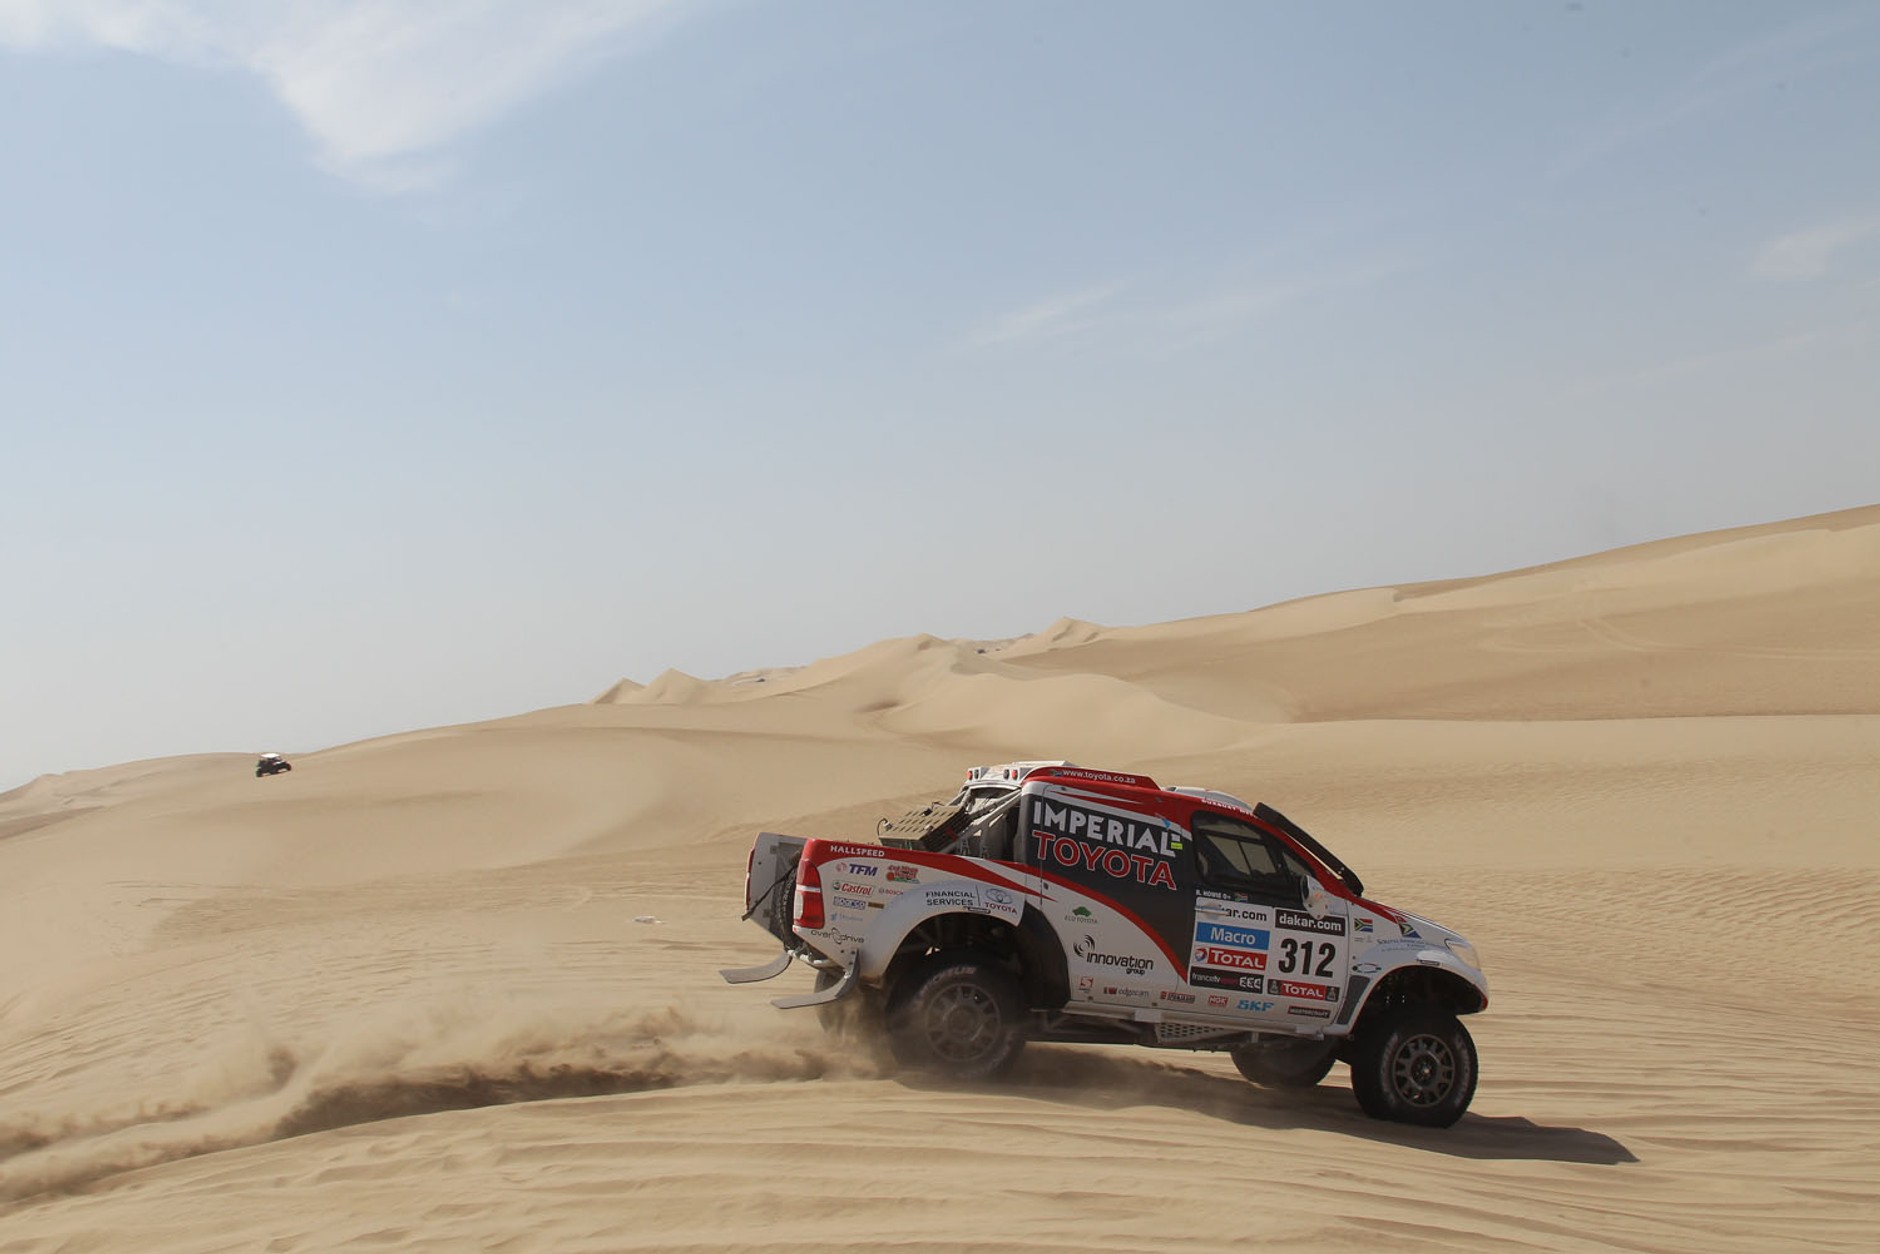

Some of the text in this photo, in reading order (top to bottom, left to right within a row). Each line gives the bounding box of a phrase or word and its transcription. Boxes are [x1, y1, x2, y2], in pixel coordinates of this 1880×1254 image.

[1062, 770, 1136, 784] www.toyota.co.za
[1033, 801, 1176, 858] IMPERIAL
[830, 845, 885, 857] HALLSPEED
[1032, 830, 1177, 891] TOYOTA
[849, 863, 878, 876] TFM
[841, 883, 873, 896] Castrol
[925, 890, 975, 899] FINANCIAL
[926, 898, 974, 906] SERVICES
[984, 901, 1018, 915] TOYOTA
[1279, 913, 1342, 932] dakar.com
[1210, 926, 1256, 945] Macro
[1086, 952, 1154, 970] innovation
[1211, 949, 1265, 969] TOTAL
[1278, 938, 1336, 978] 312
[1126, 968, 1146, 976] group
[1283, 983, 1324, 998] TOTAL
[1236, 999, 1275, 1012] SKF
